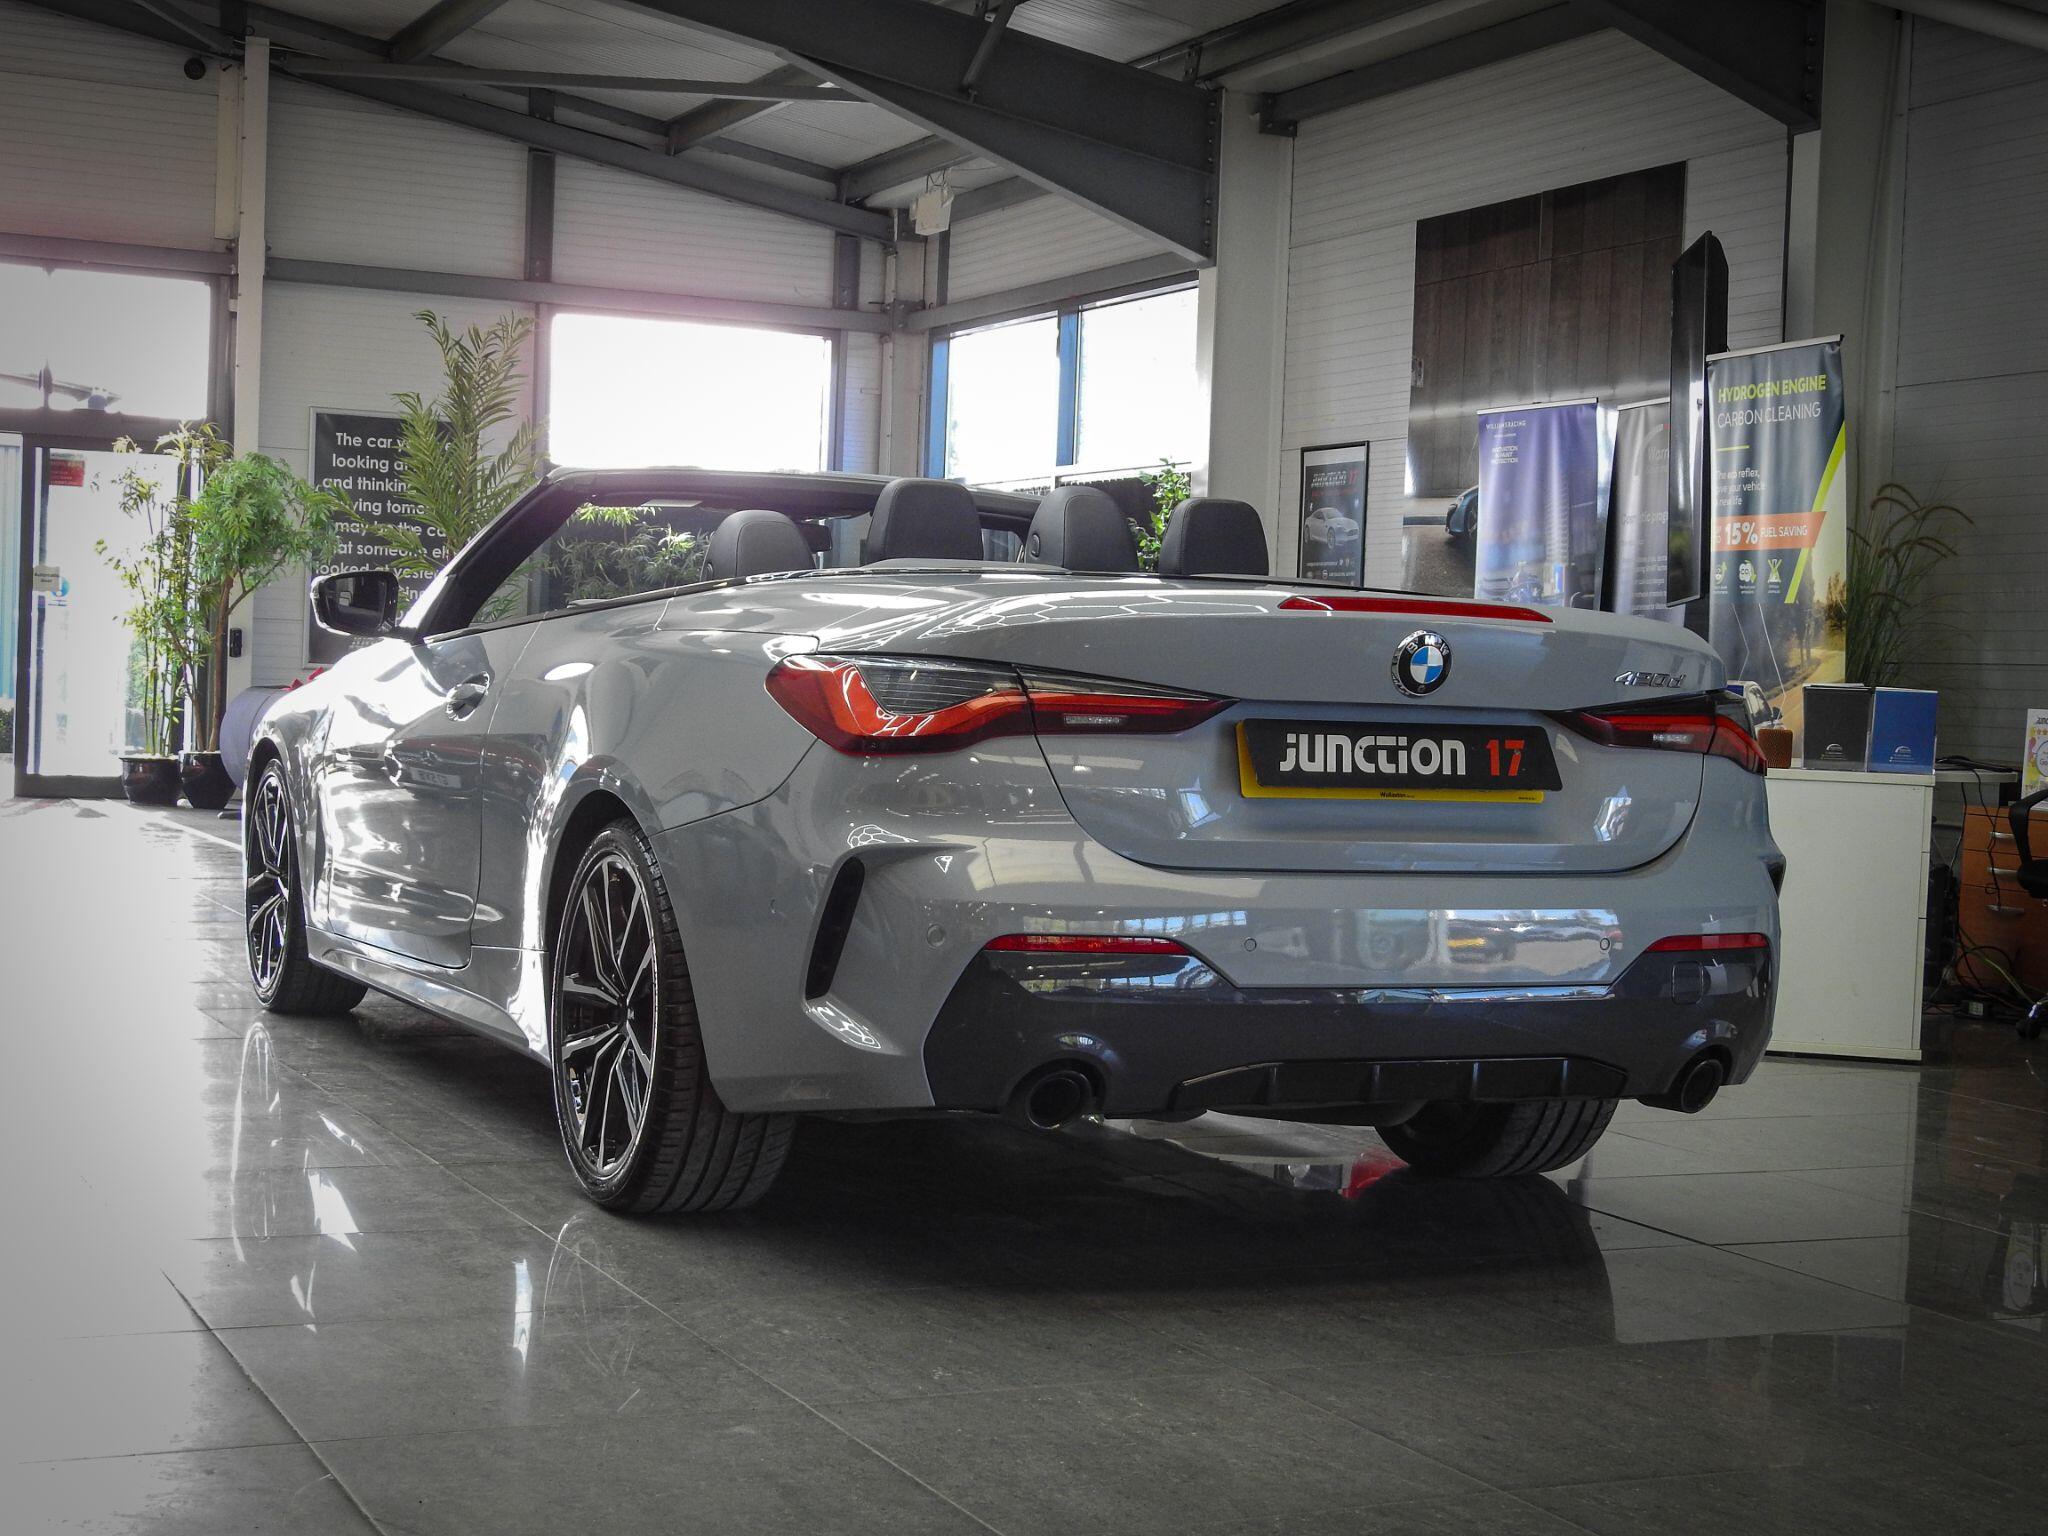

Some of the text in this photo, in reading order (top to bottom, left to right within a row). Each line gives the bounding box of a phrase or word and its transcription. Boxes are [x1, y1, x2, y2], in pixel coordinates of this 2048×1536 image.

[1718, 374, 1827, 403] HYDROGEN ENGINE
[1717, 402, 1821, 428] CARBON CLEANING
[335, 432, 363, 447] The
[366, 437, 393, 449] car
[332, 453, 389, 473] looking
[322, 476, 353, 490] and
[336, 522, 368, 536] may
[427, 526, 447, 537] ca
[1725, 521, 1758, 545] 15%
[1760, 527, 1777, 538] FUEL
[1779, 525, 1808, 537] SAVING
[1406, 634, 1450, 656] BMW
[1486, 739, 1525, 777] 17
